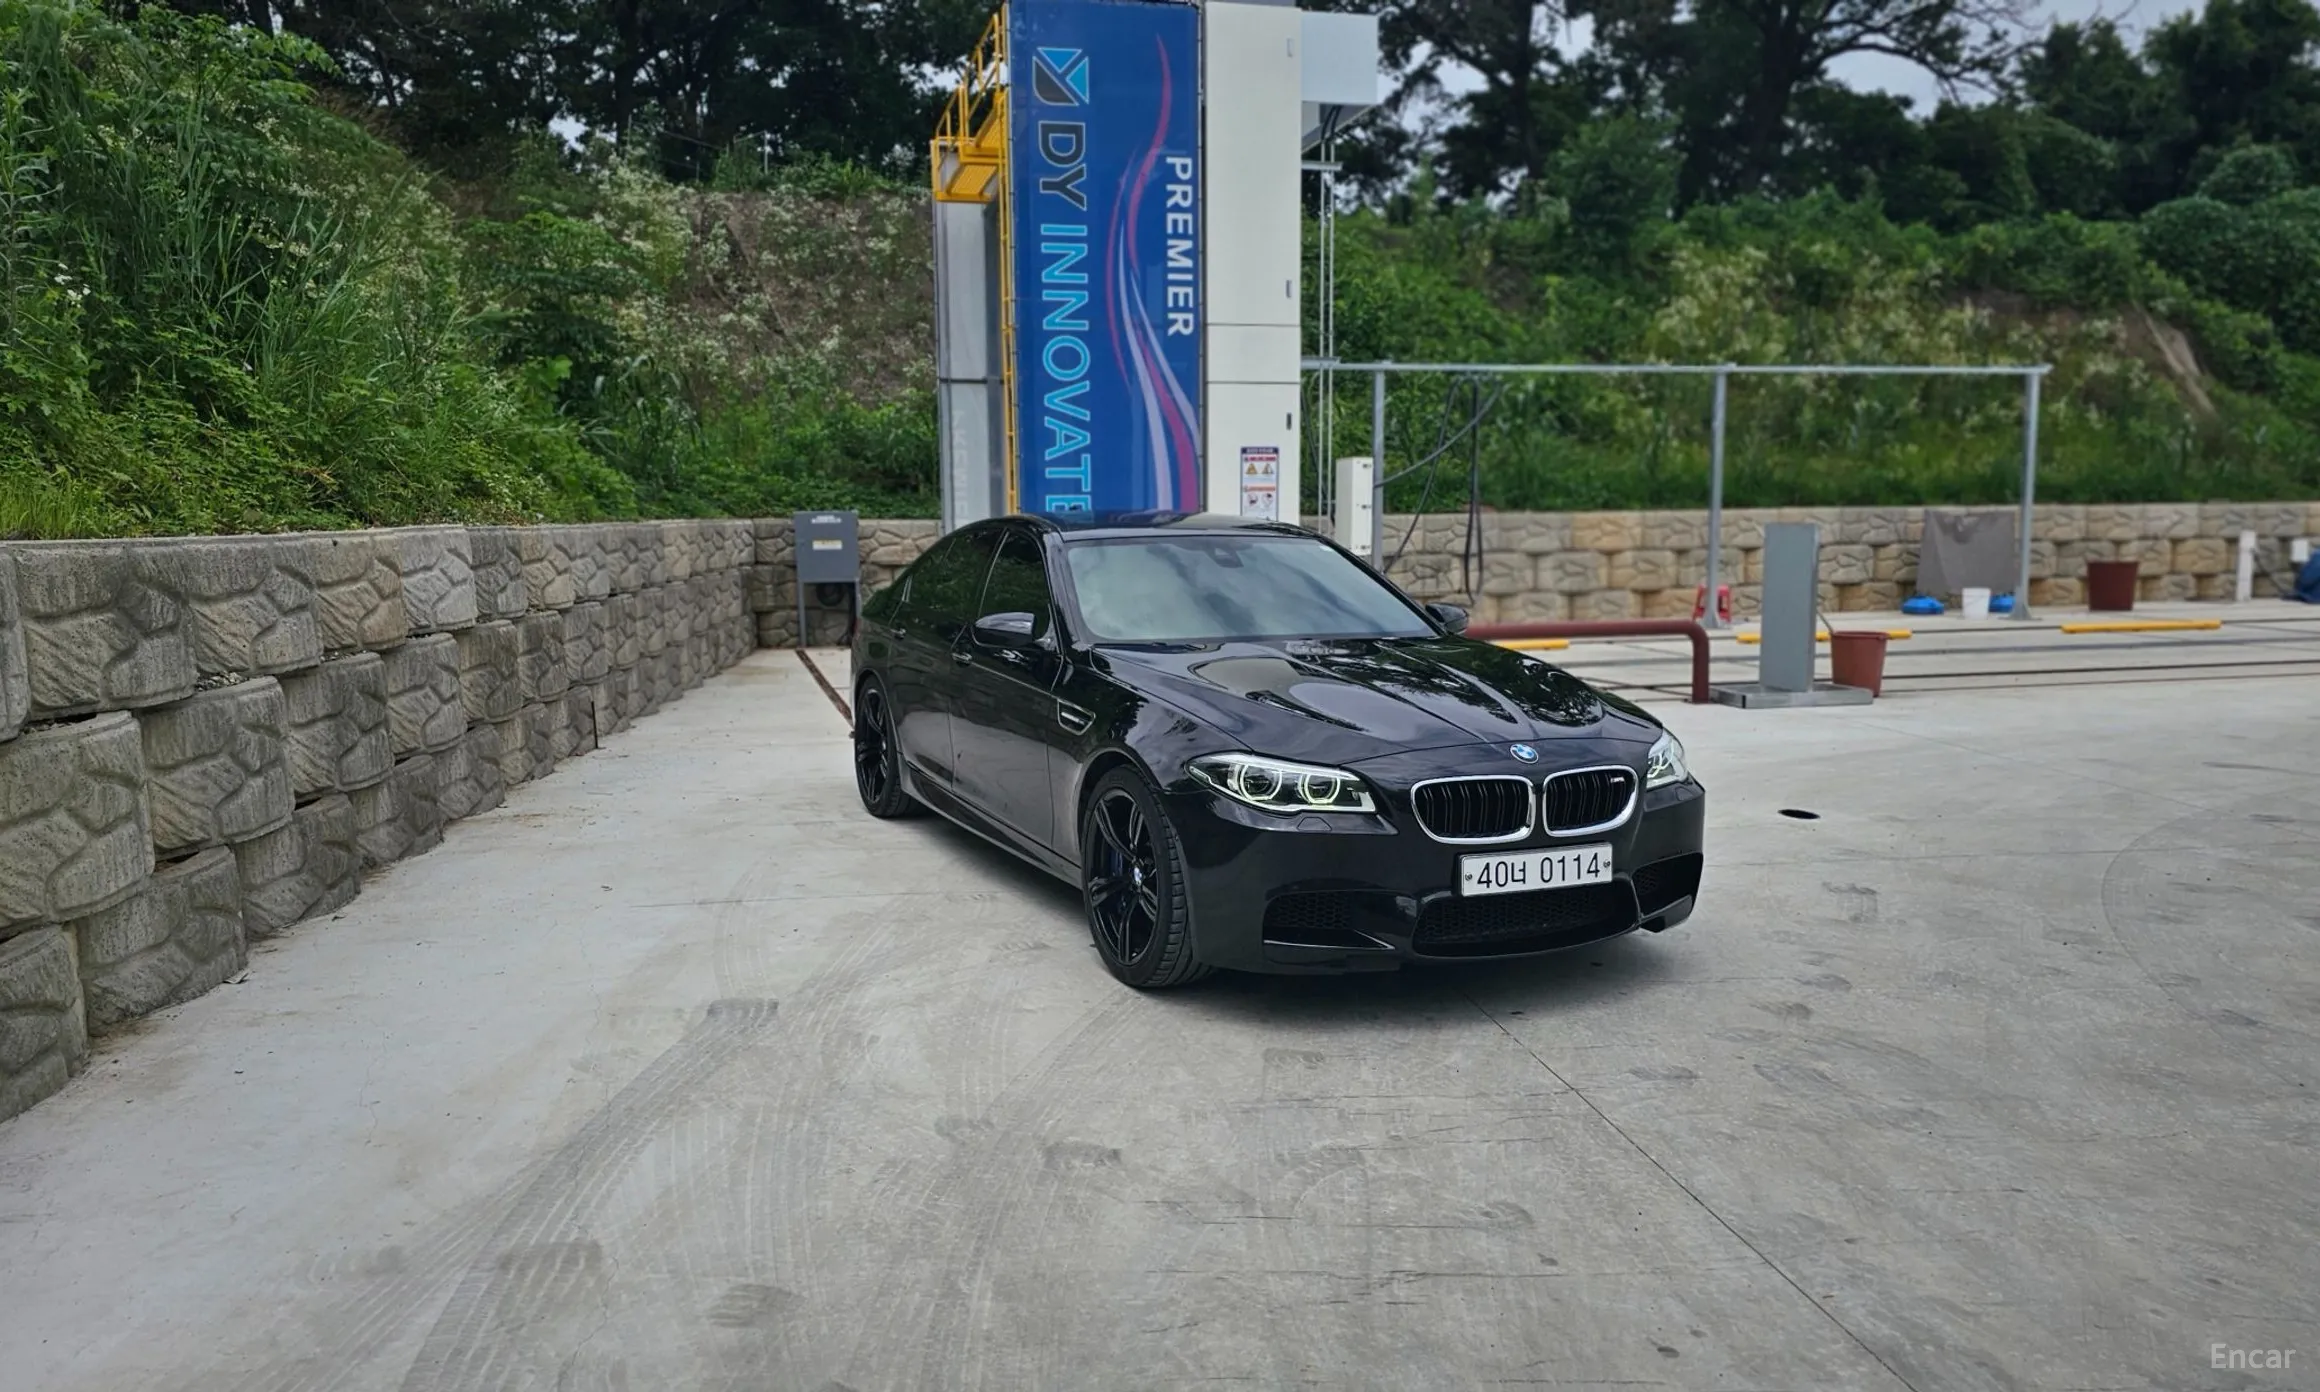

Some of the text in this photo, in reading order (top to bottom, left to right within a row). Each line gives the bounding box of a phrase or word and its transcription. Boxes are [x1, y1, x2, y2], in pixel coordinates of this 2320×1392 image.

[1038, 121, 1091, 513] DY INNOVATE
[1165, 156, 1194, 337] PREMIER
[1477, 852, 1601, 889] 40너 0114
